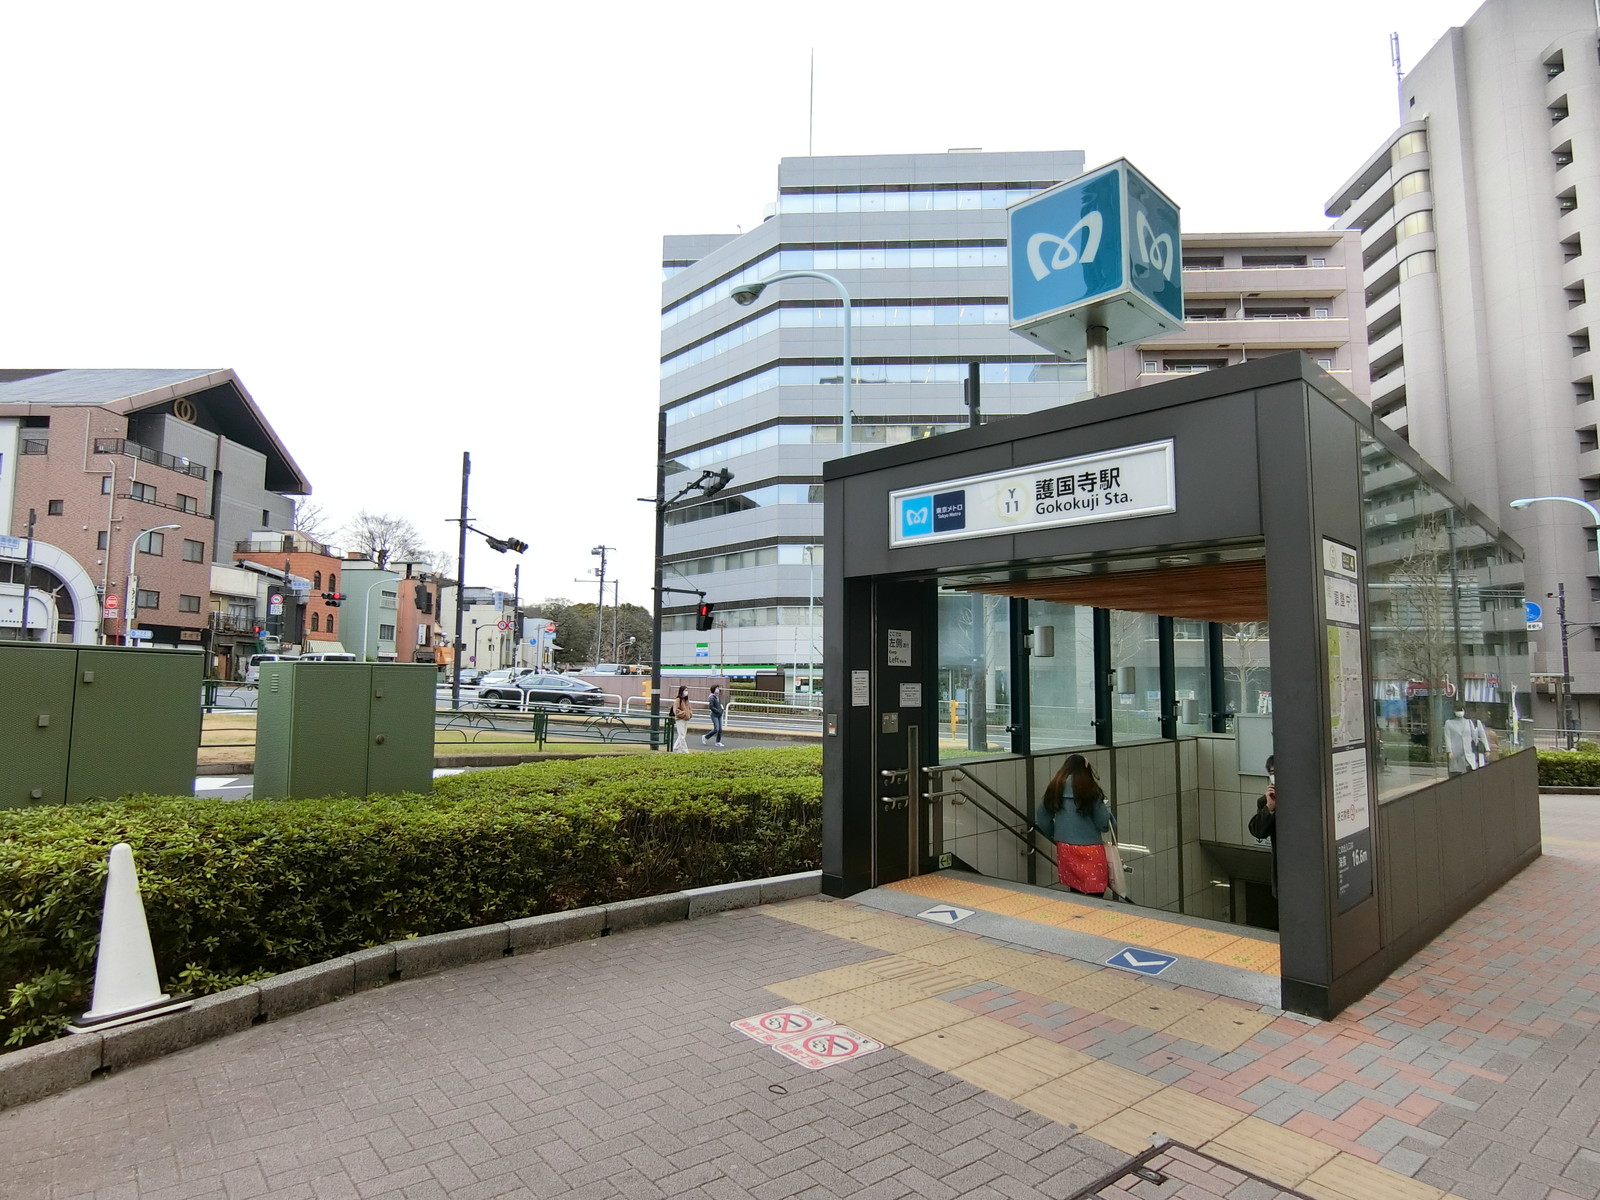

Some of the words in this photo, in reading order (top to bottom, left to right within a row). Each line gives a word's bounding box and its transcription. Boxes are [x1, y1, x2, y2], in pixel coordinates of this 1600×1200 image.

[1035, 466, 1121, 501] 護国寺駅
[1007, 487, 1017, 500] Y
[935, 503, 963, 515] 東京メトロ
[1004, 500, 1020, 514] 11
[1035, 493, 1100, 516] Gokokuji
[1104, 491, 1134, 506] Sta.
[889, 656, 900, 664] Left
[1351, 848, 1368, 867] 16.6m
